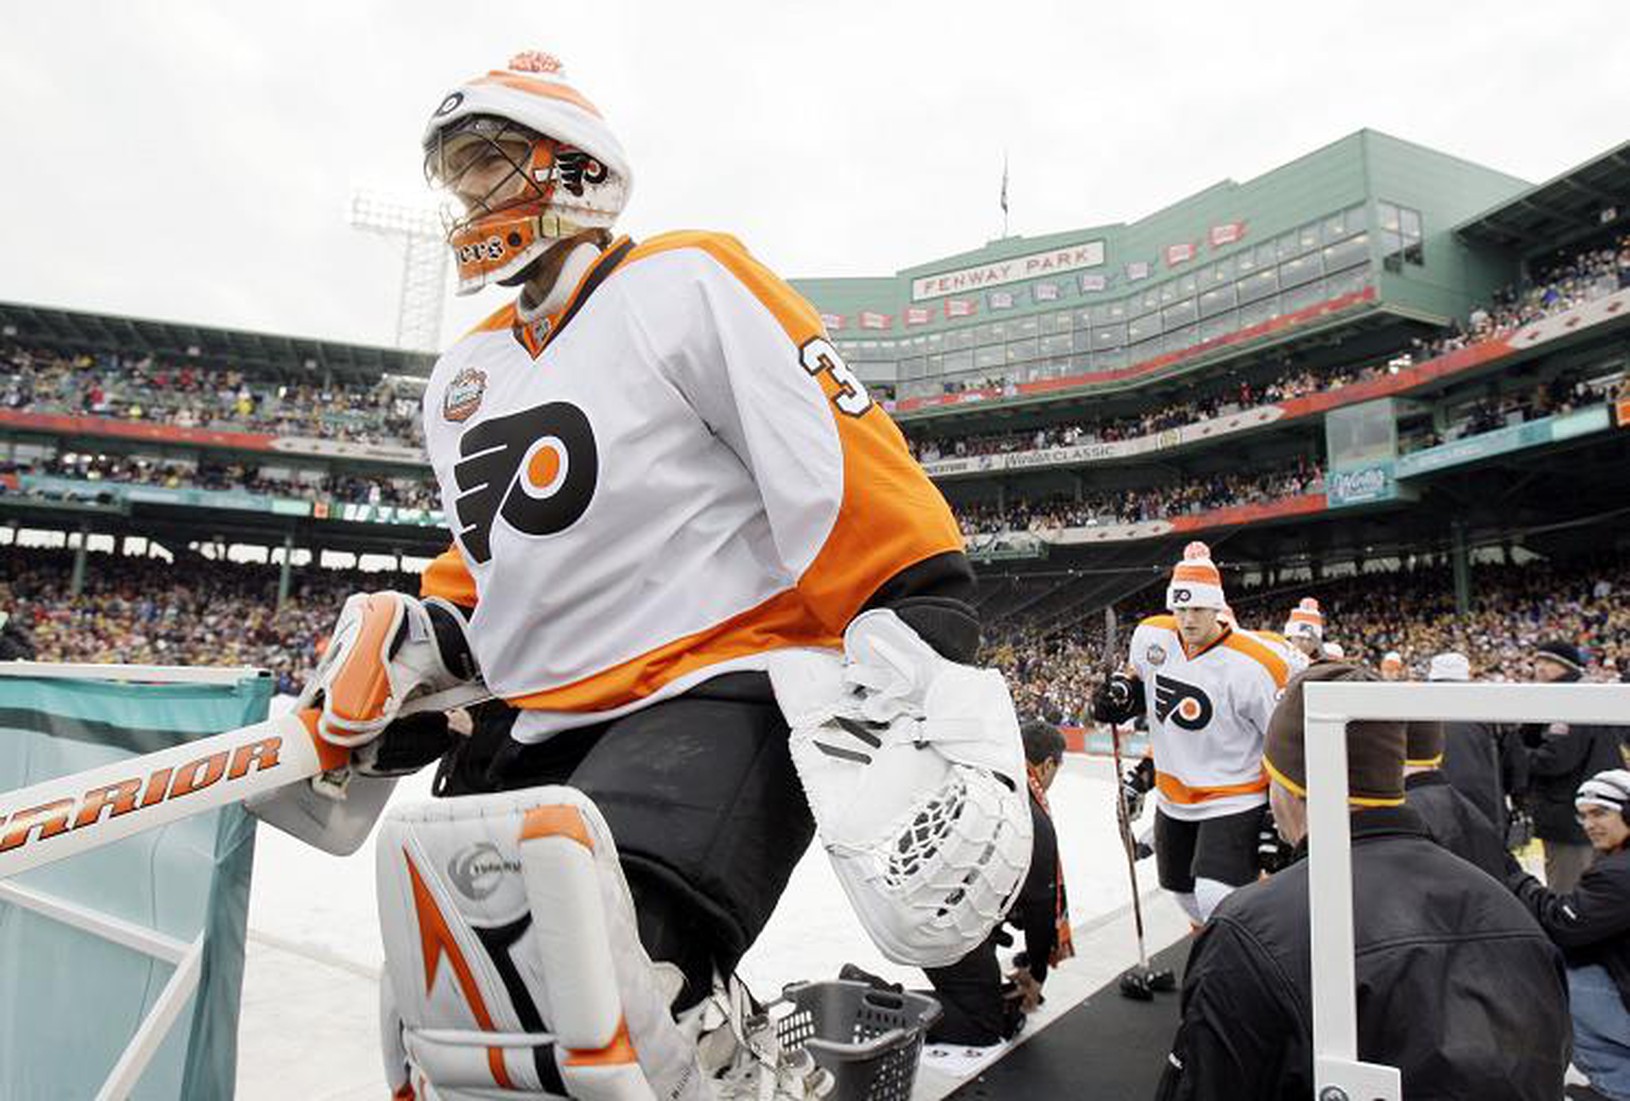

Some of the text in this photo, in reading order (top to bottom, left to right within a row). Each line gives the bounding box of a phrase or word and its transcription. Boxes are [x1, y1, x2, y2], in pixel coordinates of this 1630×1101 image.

[459, 235, 505, 264] ers
[923, 264, 1011, 294] FENWAY
[1026, 250, 1089, 273] PARK
[799, 334, 874, 419] 3
[1053, 446, 1115, 461] CLASSIC
[0, 736, 282, 854] RRIOR
